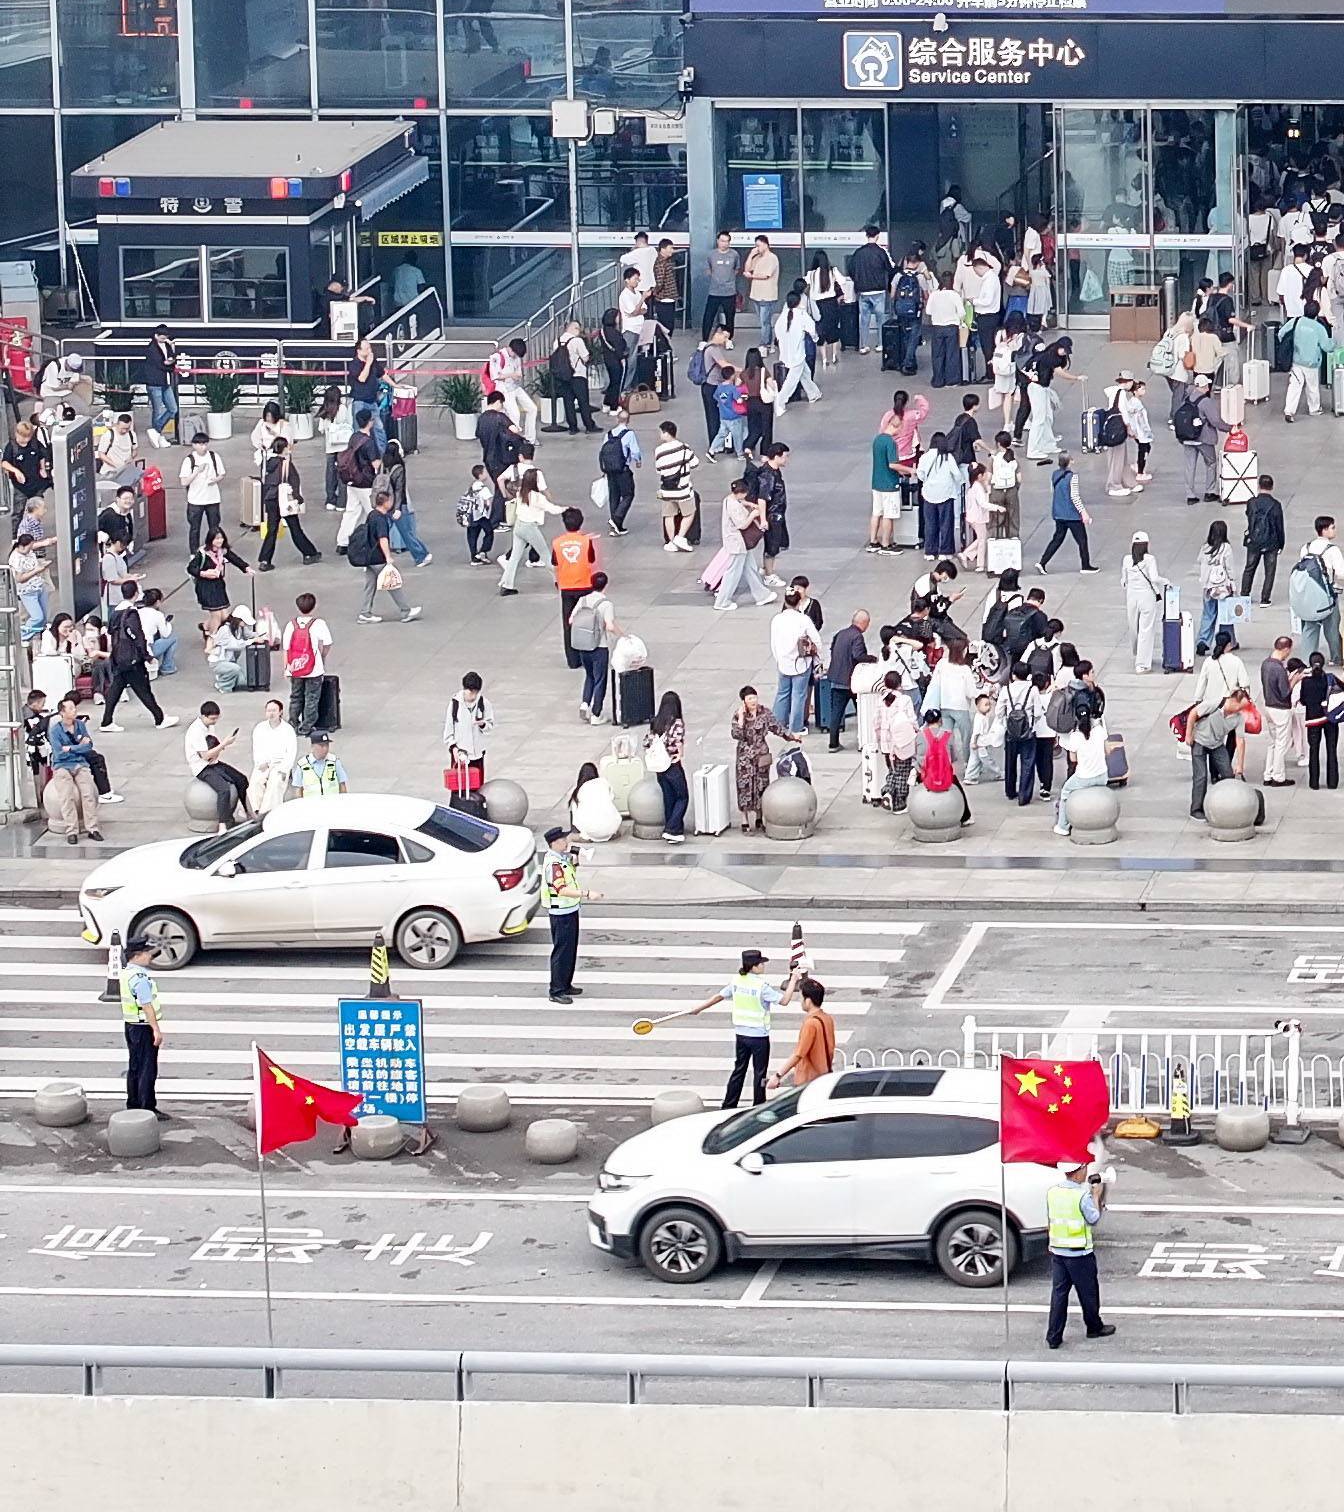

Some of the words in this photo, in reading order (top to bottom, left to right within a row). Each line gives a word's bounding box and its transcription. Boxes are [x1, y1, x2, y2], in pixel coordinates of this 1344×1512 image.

[908, 37, 1085, 67] 综合服务中心
[908, 69, 970, 84] Service
[974, 69, 1031, 84] Center
[160, 197, 179, 213] 特
[224, 197, 243, 213] 警
[0, 1224, 494, 1267] 停即走
